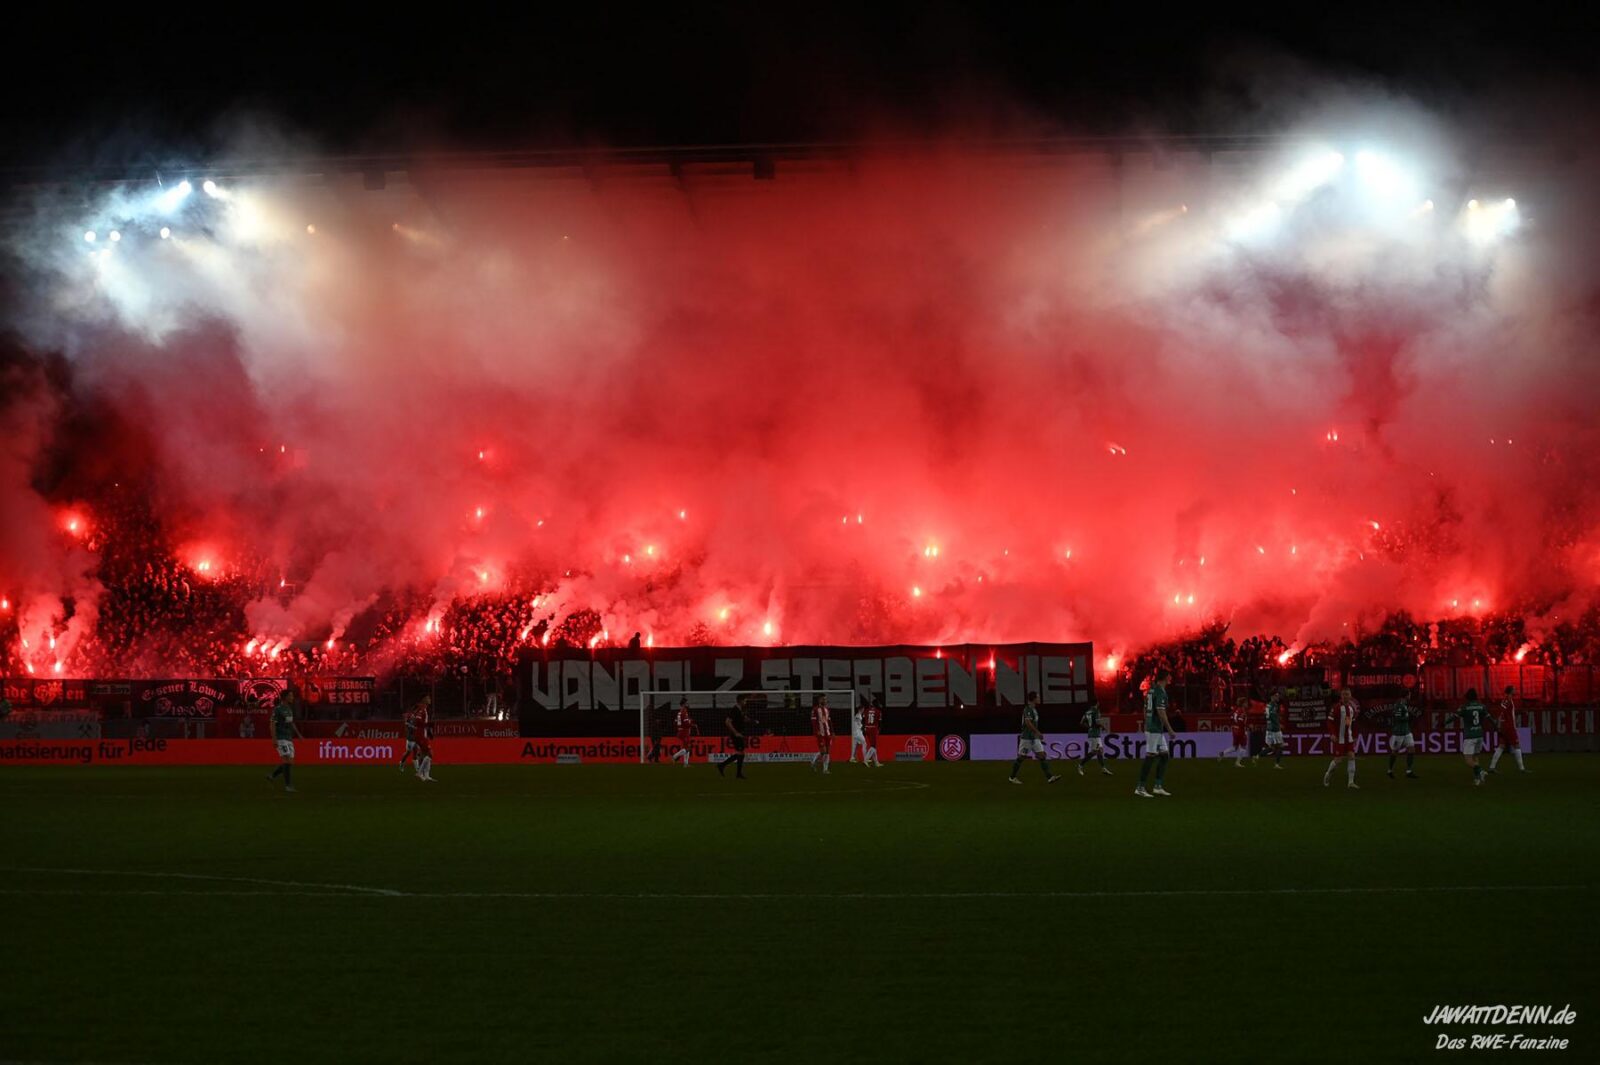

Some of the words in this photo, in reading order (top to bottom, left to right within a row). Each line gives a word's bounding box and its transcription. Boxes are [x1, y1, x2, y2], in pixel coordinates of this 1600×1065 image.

[760, 656, 978, 709] STERBEN
[995, 653, 1089, 706] NIE!
[1473, 710, 1480, 726] 3
[0, 744, 92, 762] atisierung
[99, 741, 124, 759] für
[318, 740, 393, 759] ifm.com
[522, 740, 687, 762] Automatisierng
[1353, 731, 1499, 754] WEHSEN!
